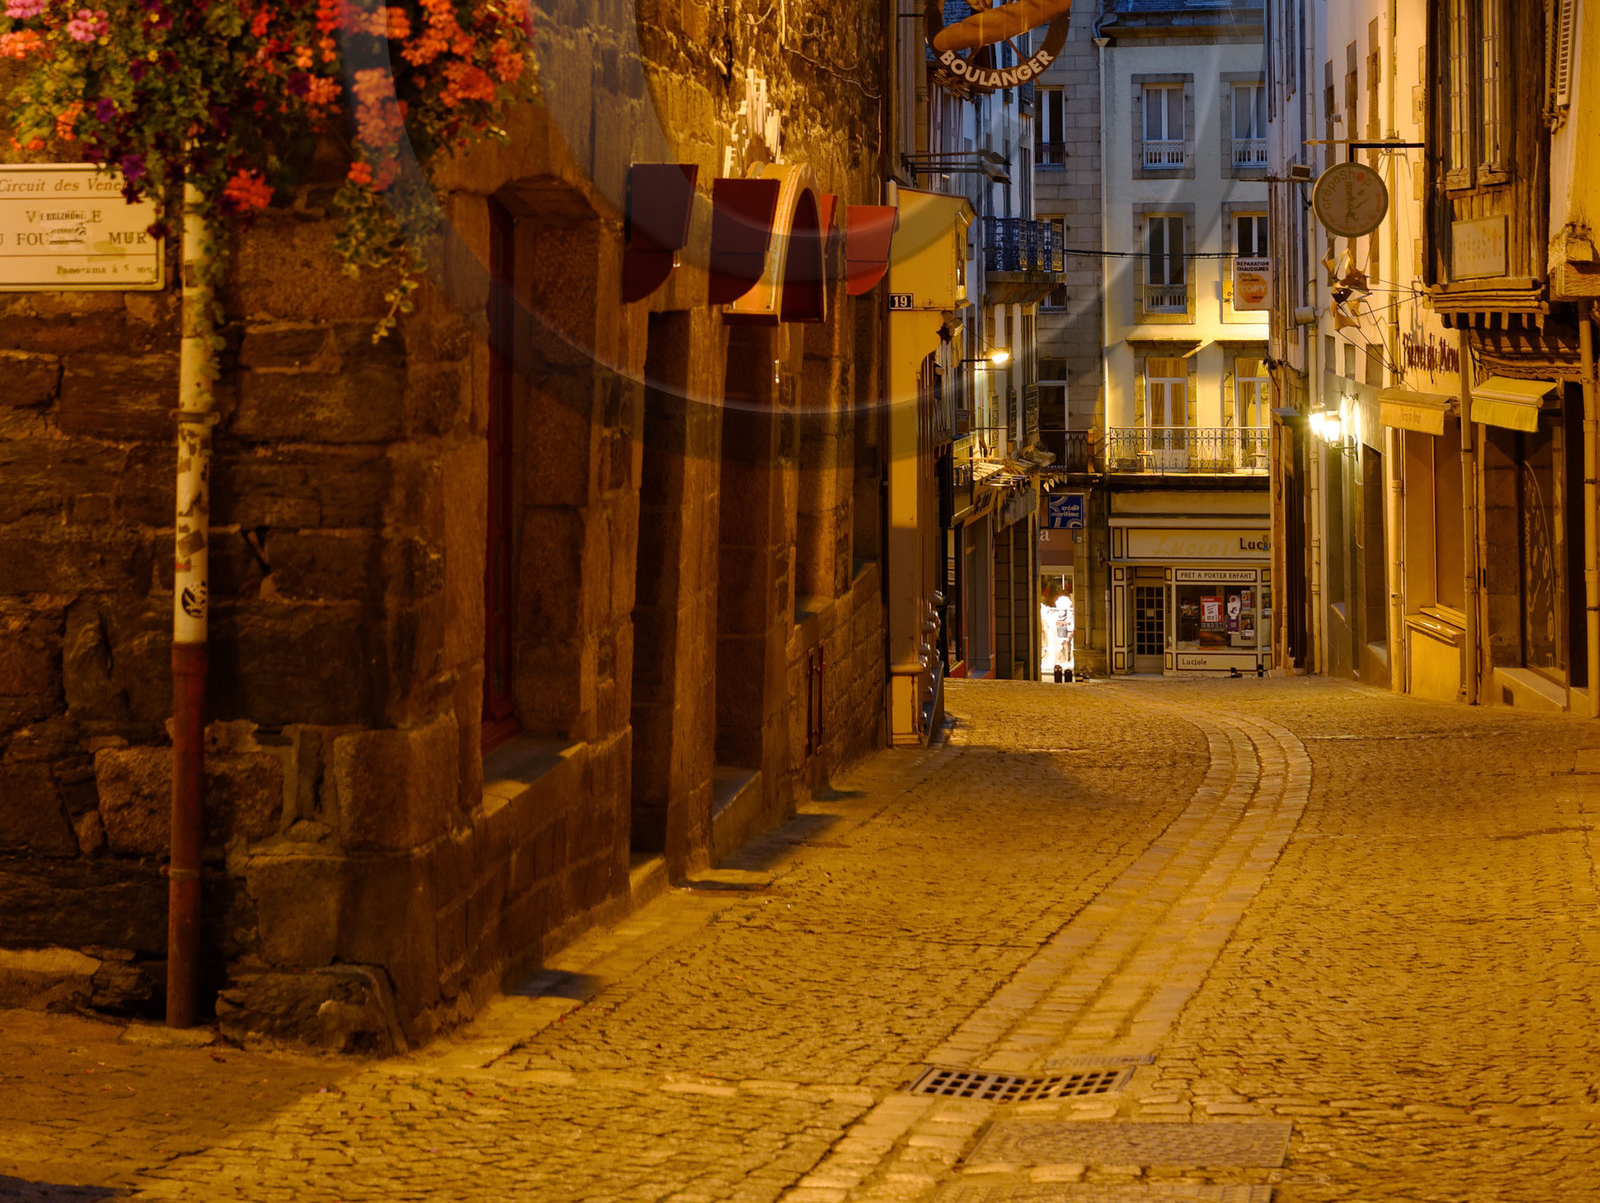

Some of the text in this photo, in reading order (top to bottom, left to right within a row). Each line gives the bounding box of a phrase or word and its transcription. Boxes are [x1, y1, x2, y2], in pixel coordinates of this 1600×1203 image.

[939, 49, 1054, 87] BOULANGER
[0, 179, 45, 192] Circuit
[54, 179, 79, 191] des
[109, 232, 148, 245] MUR
[893, 295, 908, 308] 19
